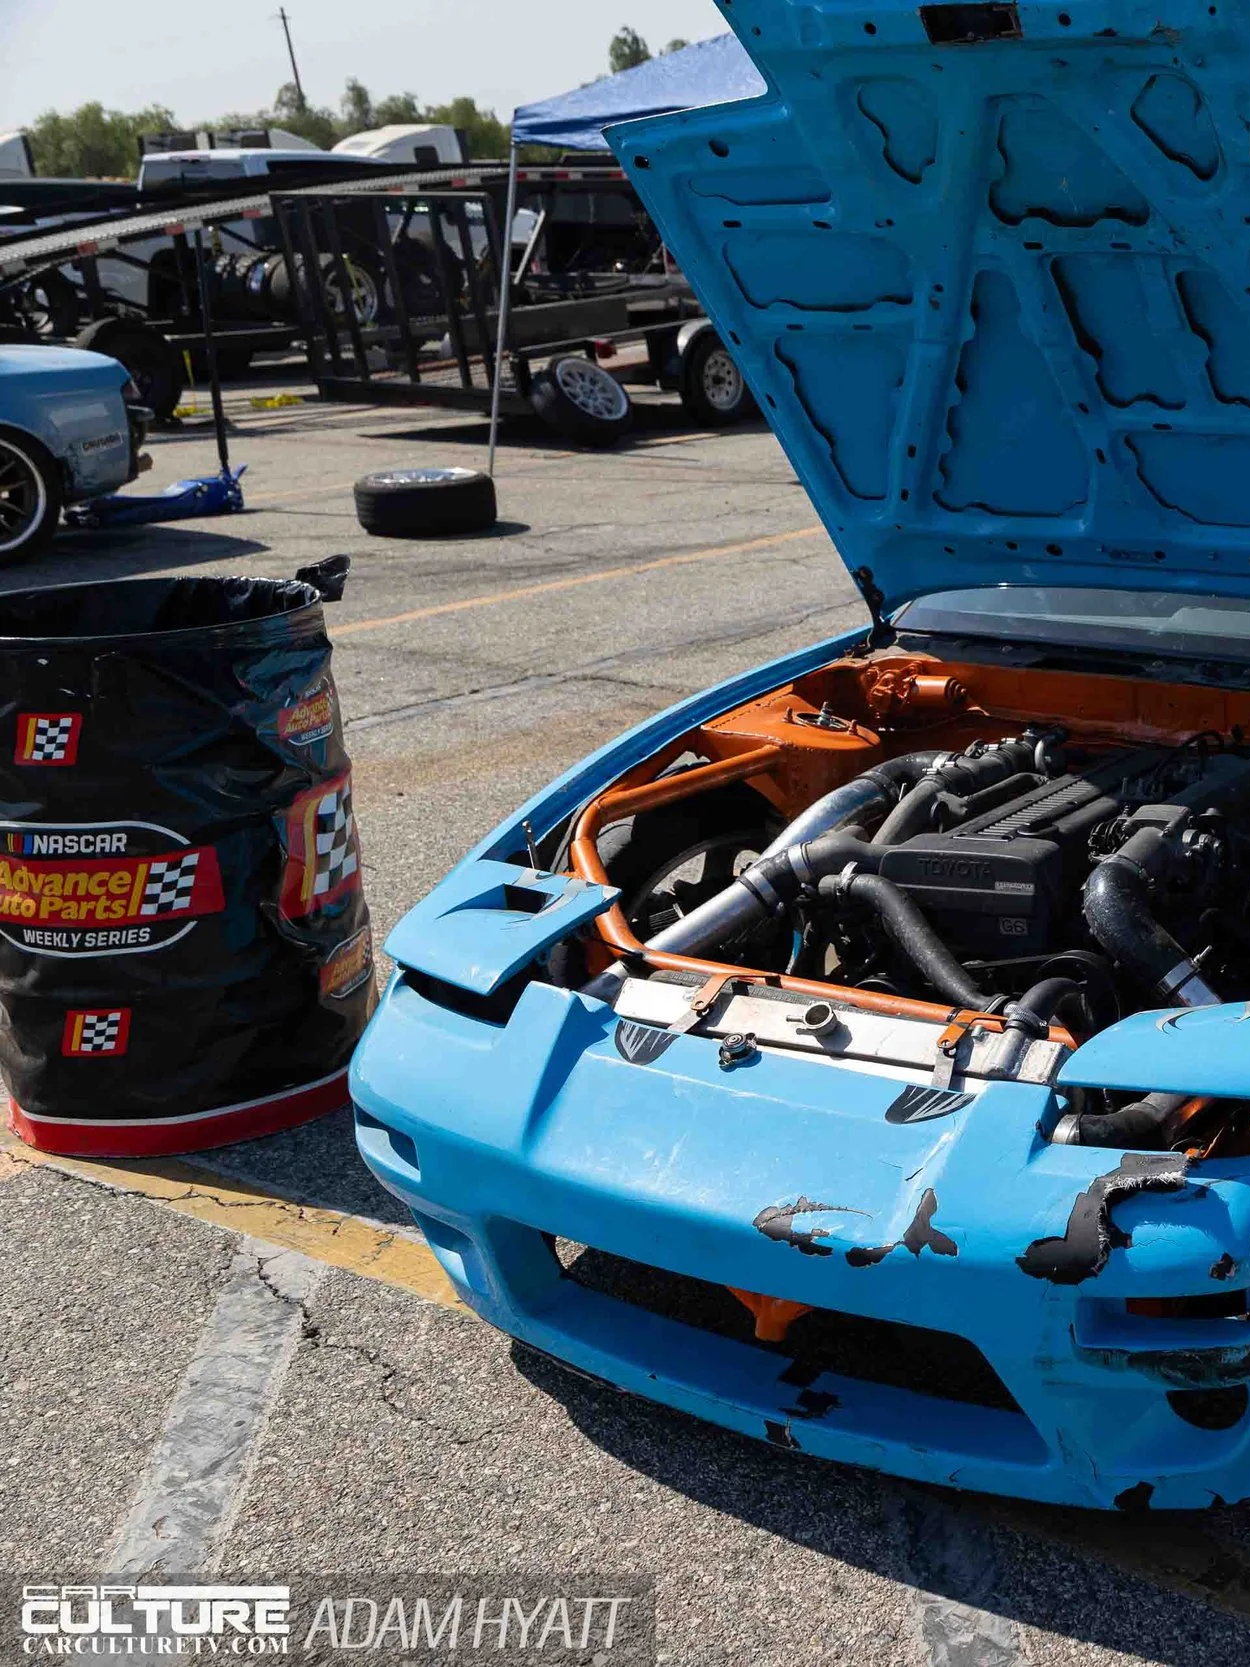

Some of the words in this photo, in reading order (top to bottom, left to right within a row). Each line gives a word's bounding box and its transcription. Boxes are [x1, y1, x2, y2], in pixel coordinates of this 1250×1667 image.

[33, 833, 128, 854] NASCAR
[918, 857, 992, 879] TOYOTA
[0, 893, 36, 916] uto
[39, 896, 126, 920] Parts
[23, 928, 82, 947] WEEKLY
[84, 927, 151, 946] SERIES
